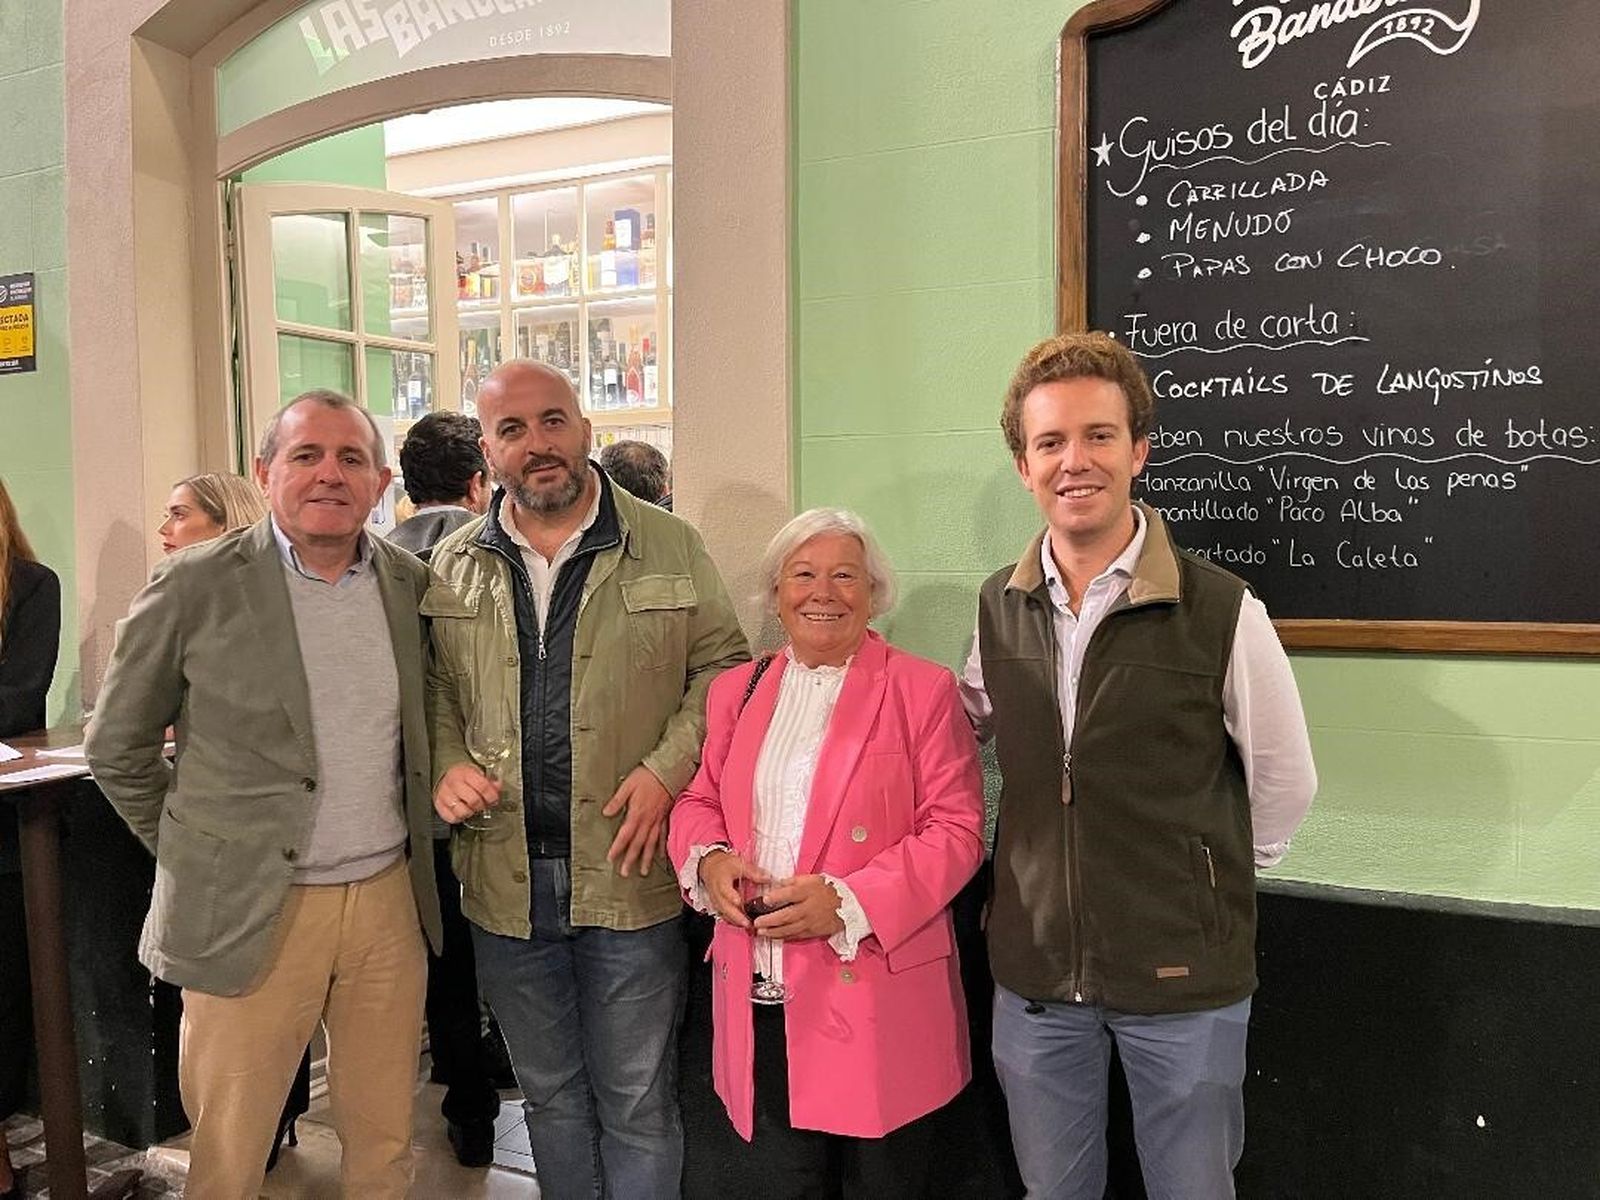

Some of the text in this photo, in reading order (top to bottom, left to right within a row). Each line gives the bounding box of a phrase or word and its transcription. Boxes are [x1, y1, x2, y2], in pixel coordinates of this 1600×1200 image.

[488, 21, 572, 48] DESDE 1892
[1384, 16, 1435, 36] 1892
[1313, 75, 1392, 100] CÁDIZ
[1106, 116, 1234, 197] Guisos
[1247, 104, 1298, 145] del
[1166, 170, 1330, 208] CARRILLADA
[1274, 249, 1323, 272] CON
[1123, 313, 1198, 349] Fuera
[1215, 309, 1248, 341] de
[1312, 372, 1354, 397] DE
[1223, 418, 1344, 447] nuestros
[1362, 423, 1435, 447] vinos
[1456, 418, 1488, 447] de
[1353, 469, 1376, 490] de
[1395, 467, 1430, 490] las
